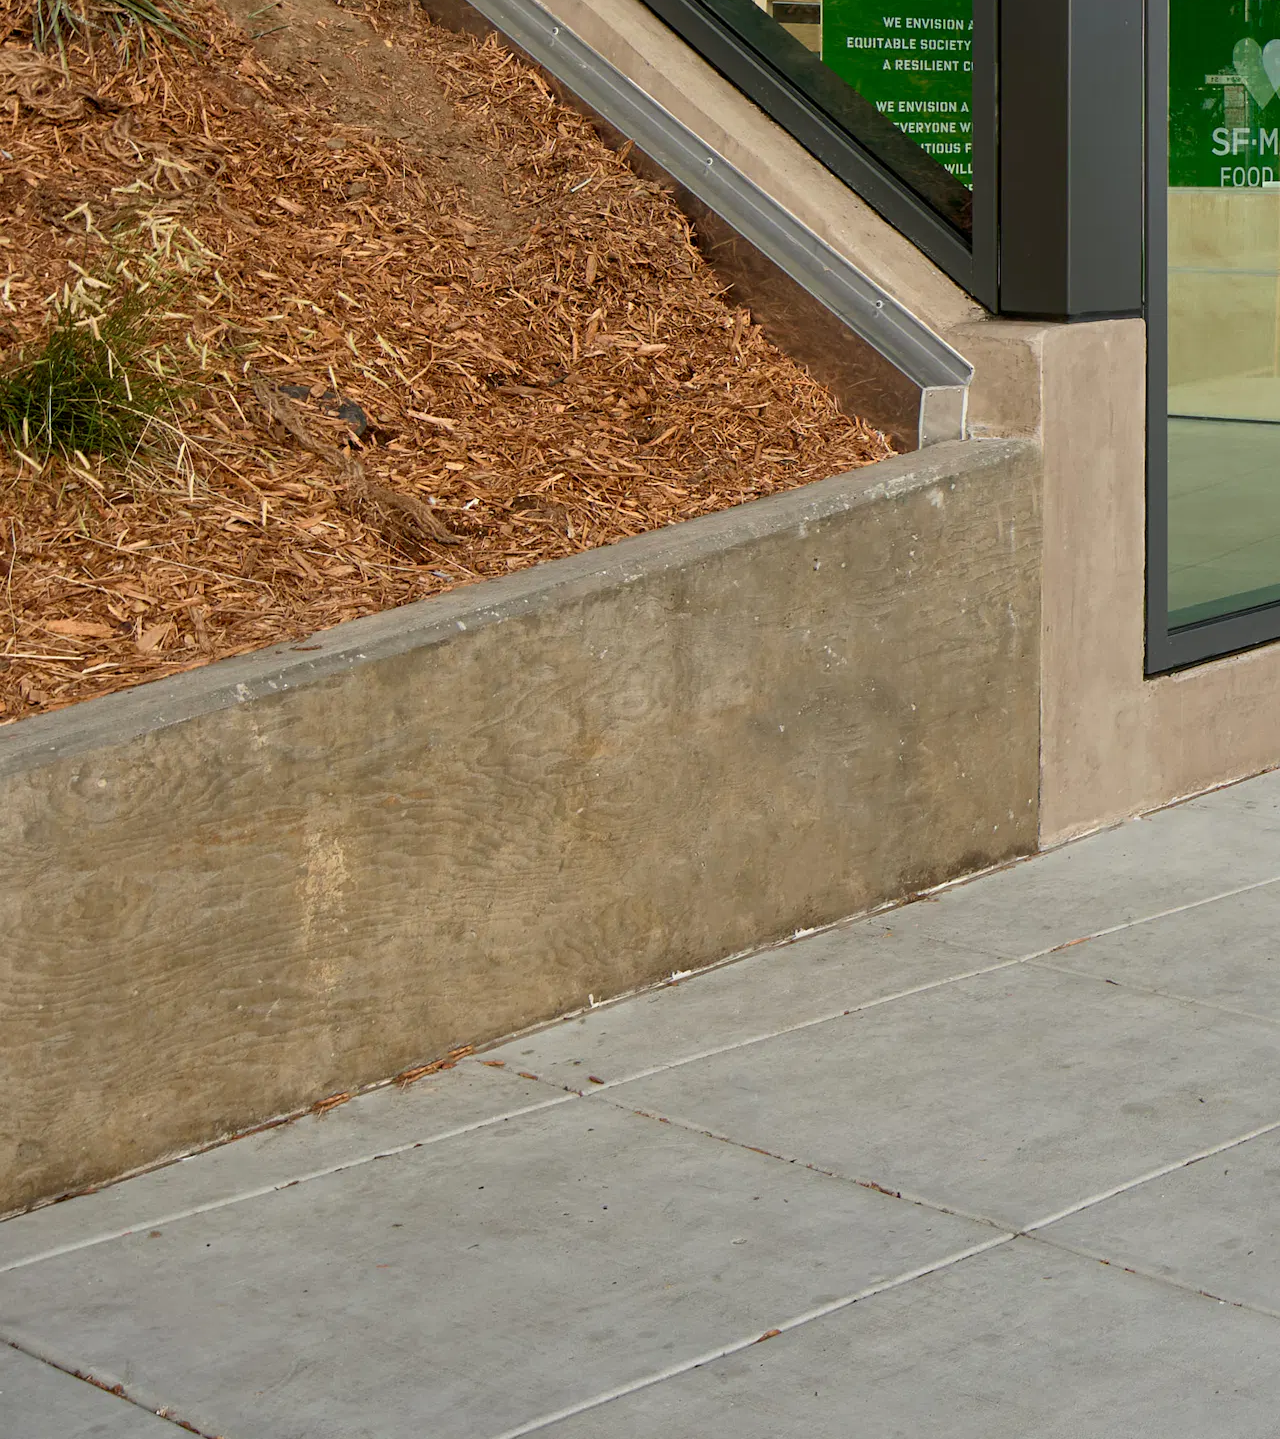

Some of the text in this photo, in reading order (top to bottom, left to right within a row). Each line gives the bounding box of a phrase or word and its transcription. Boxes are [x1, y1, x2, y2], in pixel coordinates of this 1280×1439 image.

[883, 16, 902, 28] WE
[905, 17, 964, 30] ENVISION
[846, 36, 972, 51] EQUITABLE SOCIETY
[883, 59, 892, 71] A
[895, 59, 959, 72] RESILIENT
[876, 101, 969, 113] WE ENVISION A
[893, 121, 956, 134] VERYONE
[1220, 166, 1273, 188] FOOD
